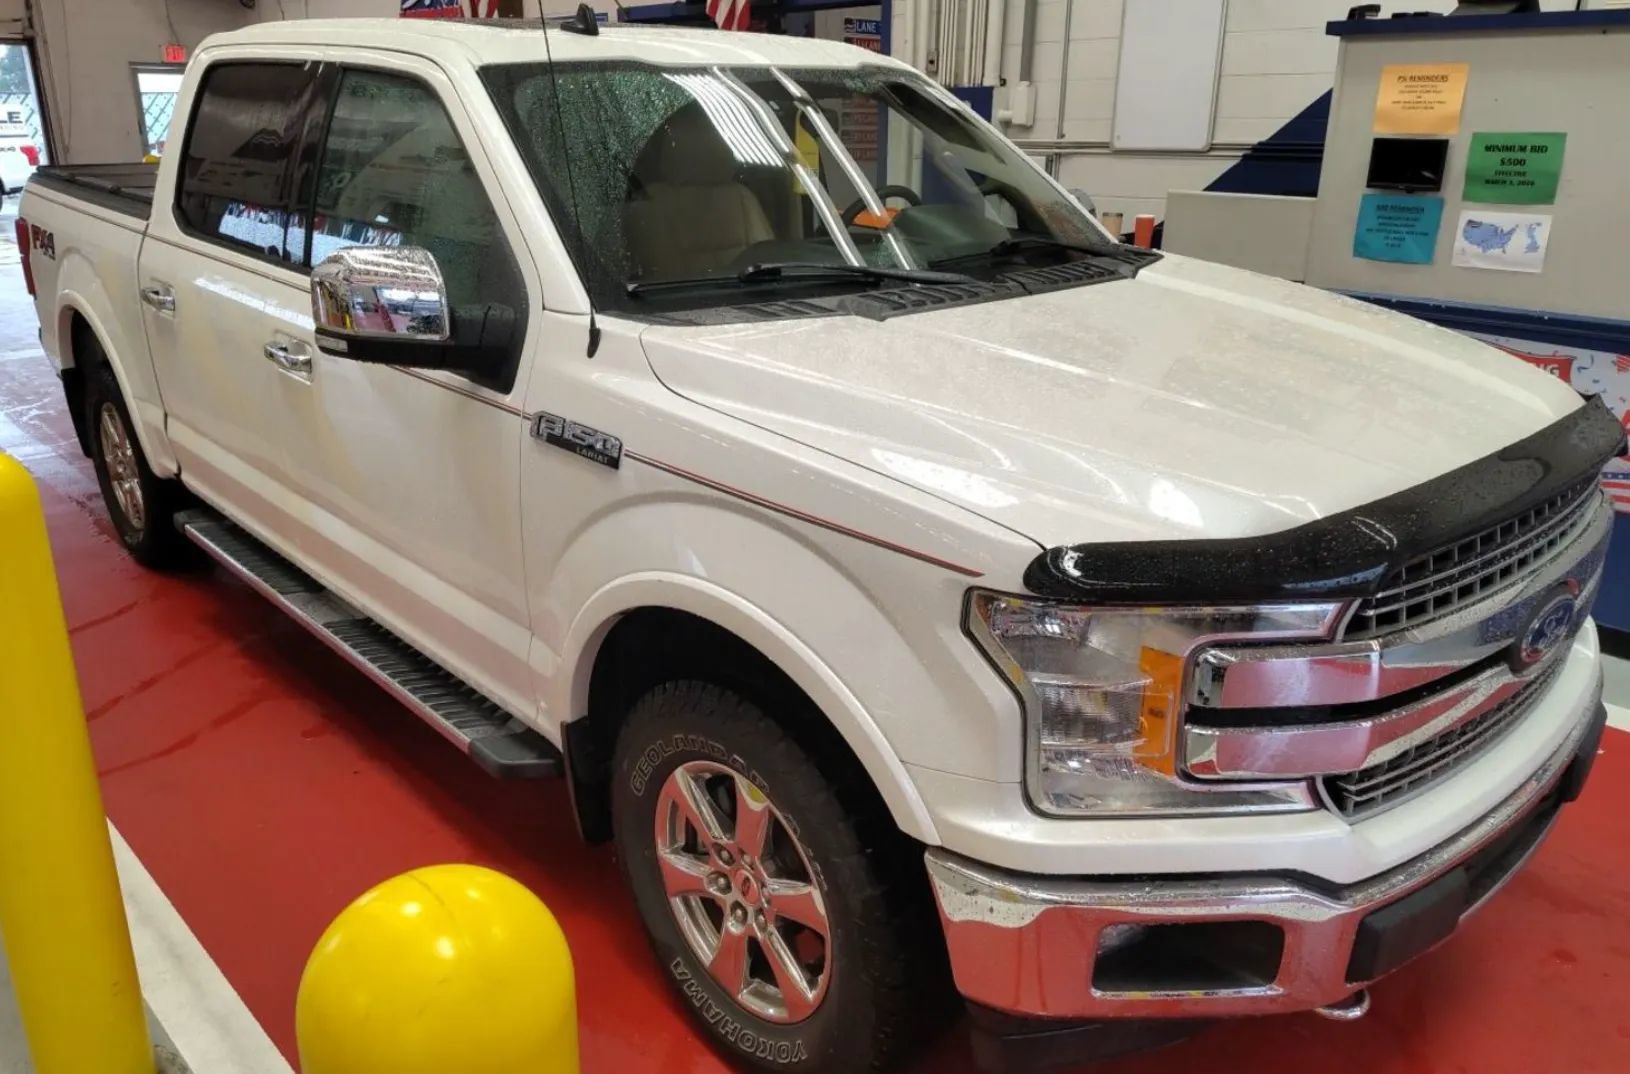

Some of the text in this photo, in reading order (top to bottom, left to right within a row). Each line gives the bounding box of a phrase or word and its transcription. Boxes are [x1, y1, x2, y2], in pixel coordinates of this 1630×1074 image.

[855, 21, 877, 33] LANE
[1484, 144, 1549, 154] MINIMUM BID
[1499, 157, 1527, 167] $500
[576, 446, 610, 465] LARIAT
[631, 733, 771, 798] GEOLANDAR
[670, 957, 809, 1063] YOKOHAMA
